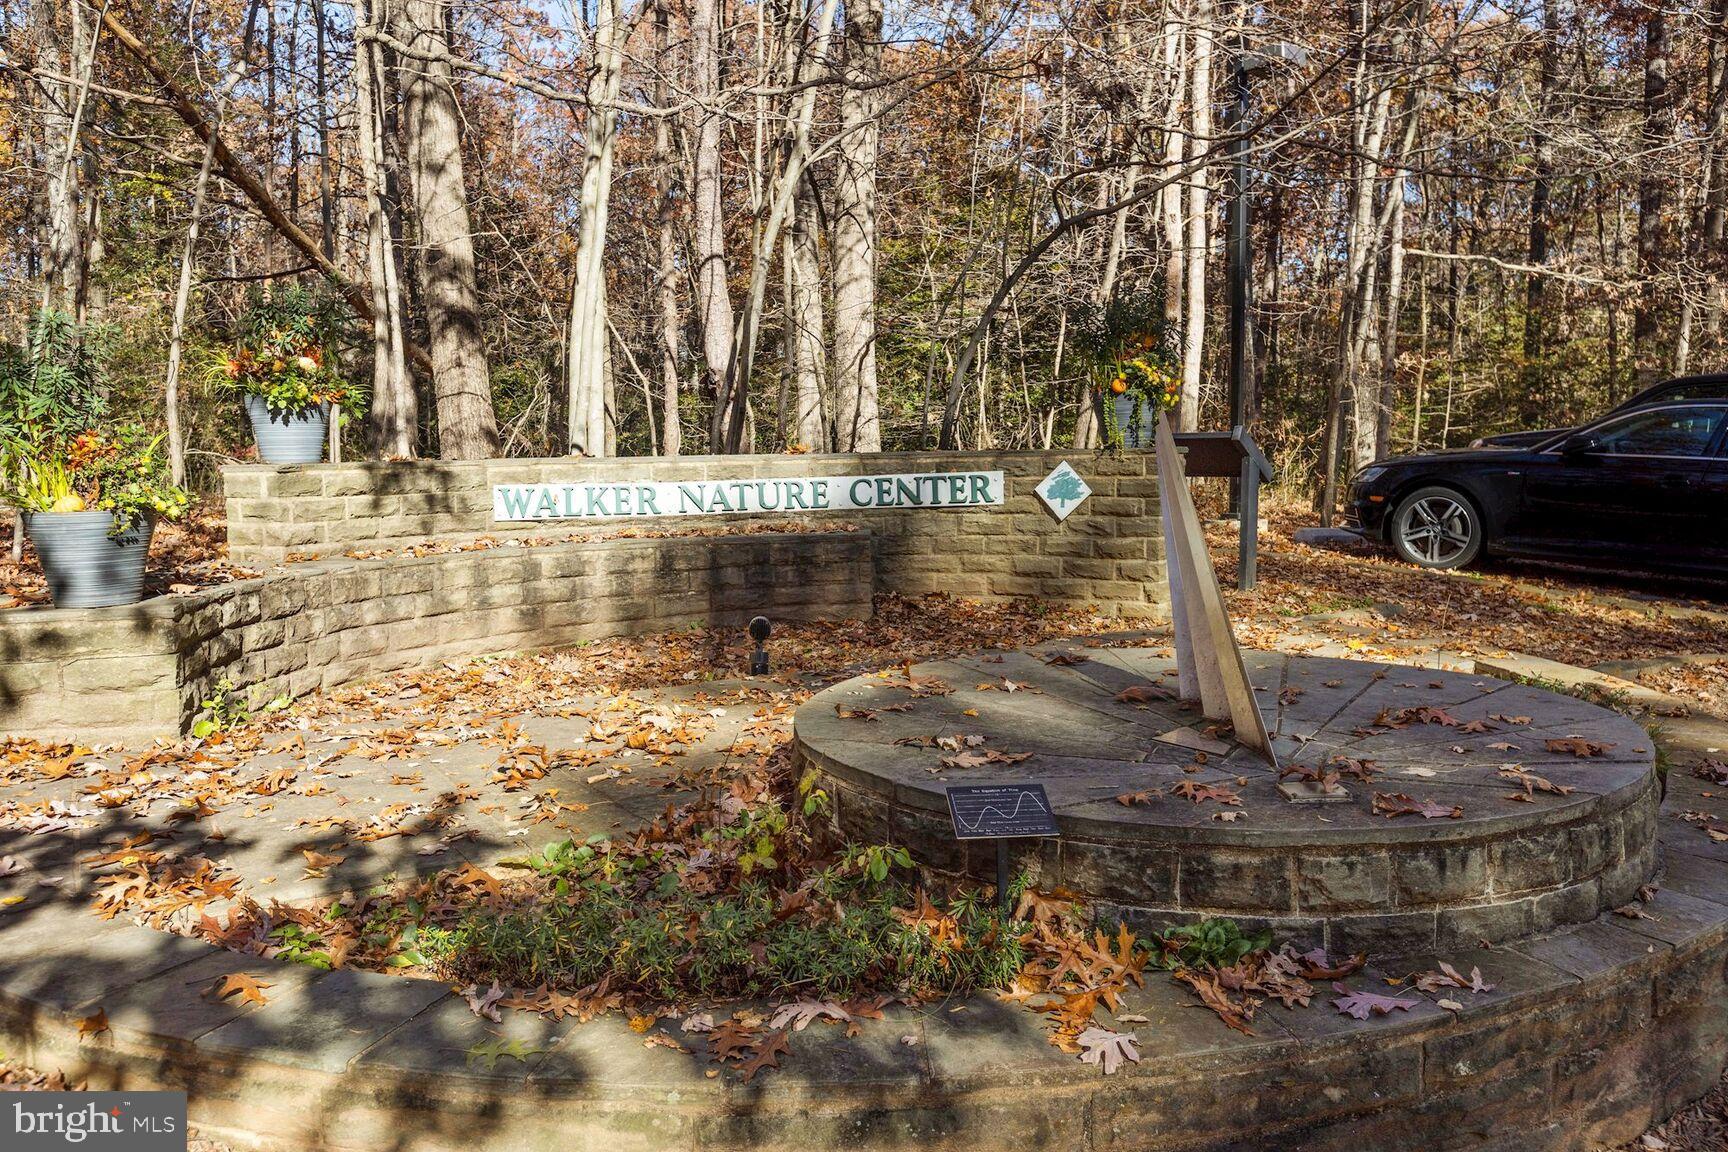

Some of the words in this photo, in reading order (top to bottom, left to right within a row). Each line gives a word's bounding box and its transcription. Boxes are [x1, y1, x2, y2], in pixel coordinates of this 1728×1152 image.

[498, 486, 663, 519] WALKER
[677, 479, 830, 513] NATURE
[849, 474, 996, 507] CENTER
